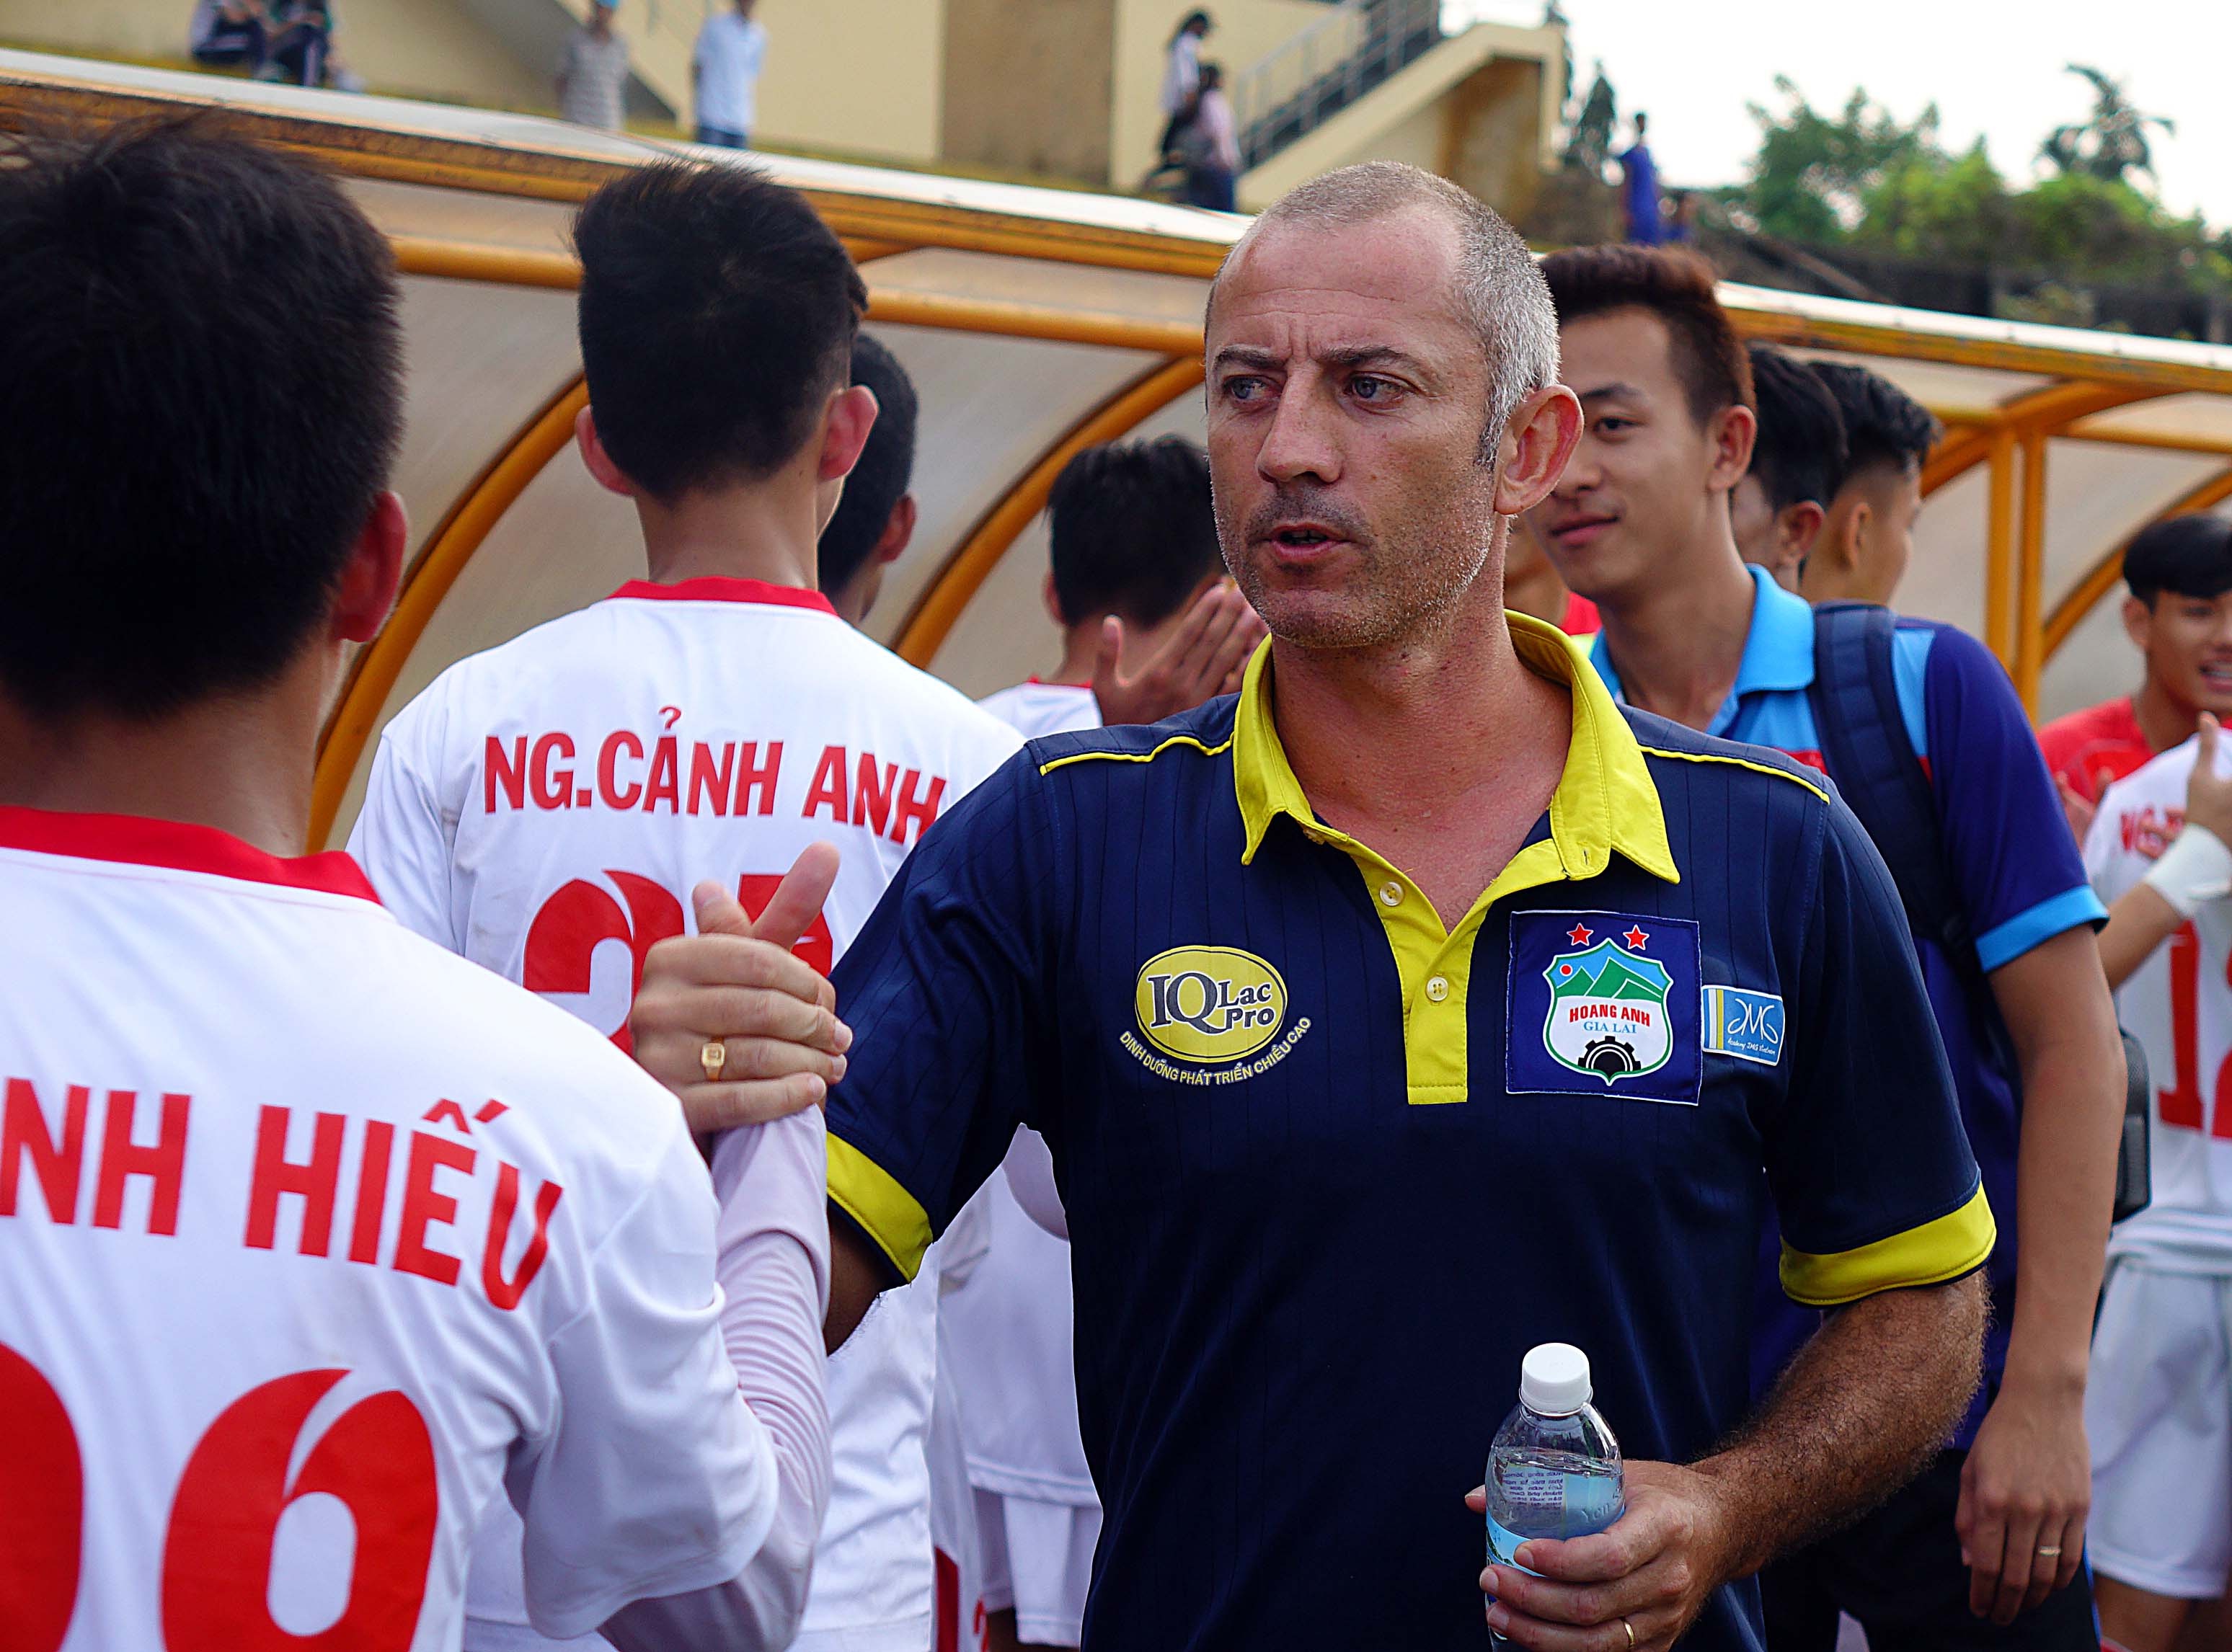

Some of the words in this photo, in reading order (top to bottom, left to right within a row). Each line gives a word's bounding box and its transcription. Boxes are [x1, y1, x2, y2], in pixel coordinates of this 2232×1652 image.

[484, 705, 784, 818] NG.CẢNH
[801, 745, 947, 846] ANH
[1226, 1008, 1275, 1030] Pro
[1569, 1004, 1617, 1023] HOANG
[1620, 1007, 1650, 1027] ANH
[1583, 1021, 1609, 1032] GIA
[1613, 1023, 1637, 1034] LAI
[1179, 1069, 1212, 1085] PHÁT
[1286, 1017, 1311, 1044] CAO
[244, 1098, 563, 1310] HIẾU
